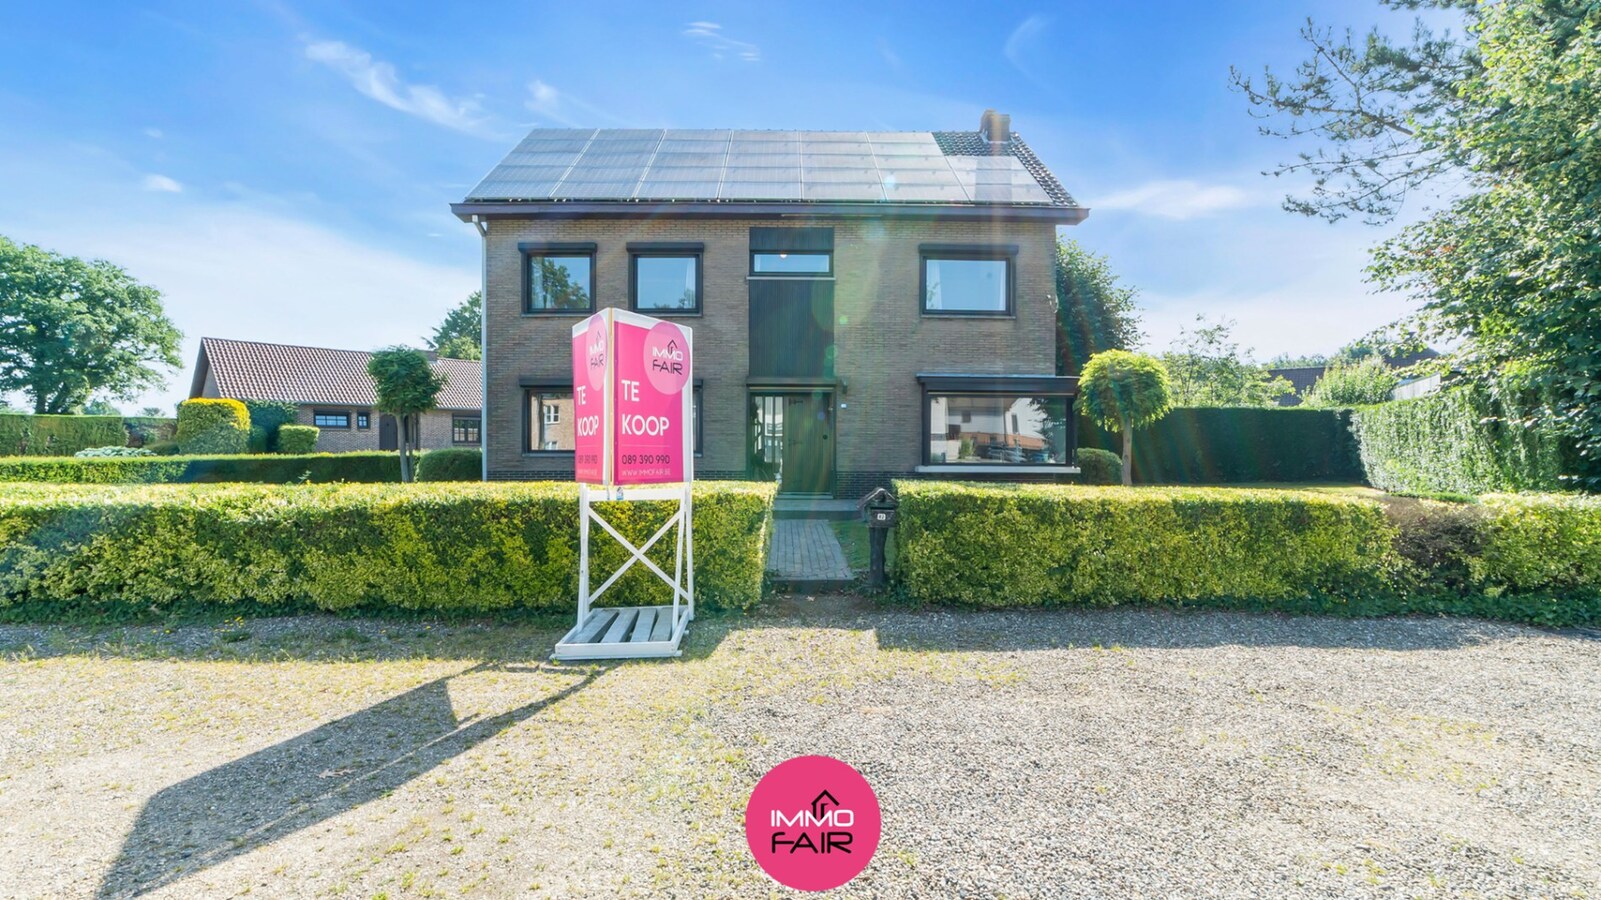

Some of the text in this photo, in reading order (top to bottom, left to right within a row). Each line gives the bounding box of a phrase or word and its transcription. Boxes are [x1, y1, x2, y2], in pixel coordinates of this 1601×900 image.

[652, 347, 684, 361] IMMO
[652, 360, 683, 375] FAIR
[576, 385, 586, 405] TE
[621, 379, 640, 402] TE
[577, 415, 599, 437] KOOP
[621, 414, 670, 436] KOOP
[621, 454, 671, 465] 089 390 990
